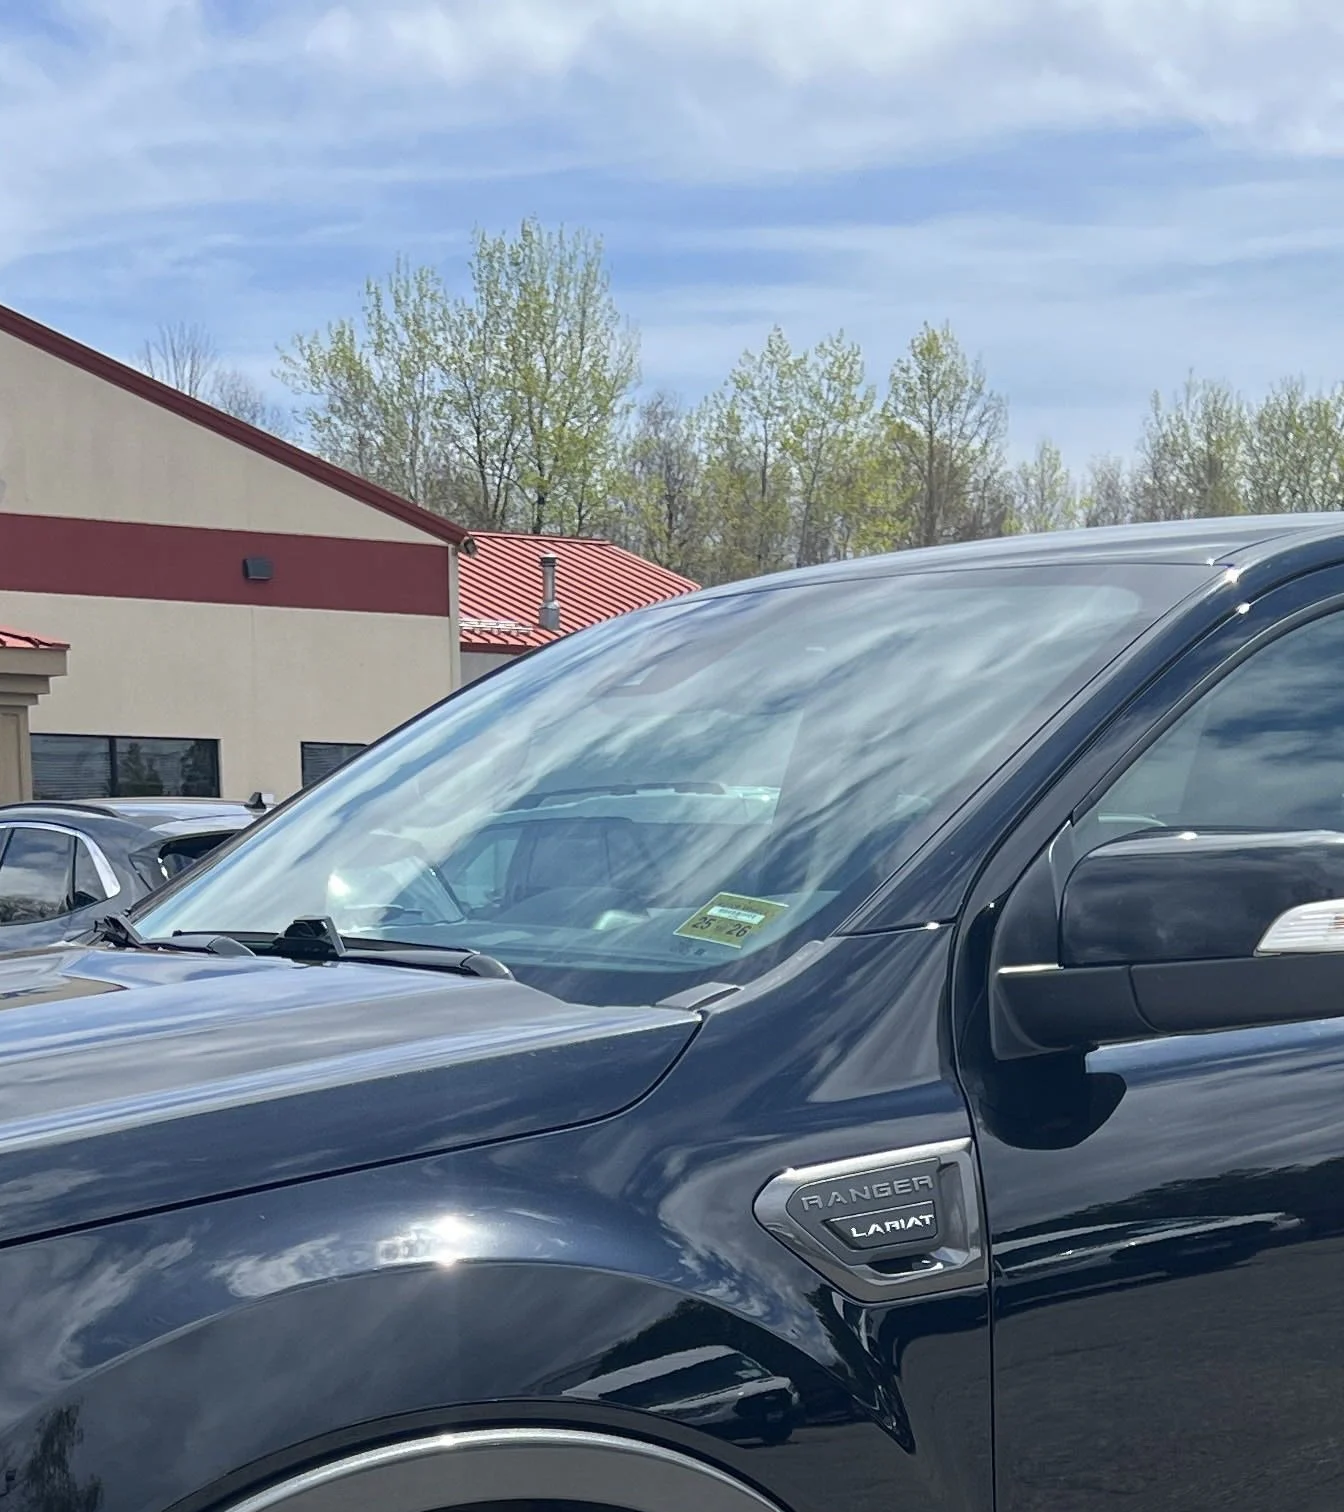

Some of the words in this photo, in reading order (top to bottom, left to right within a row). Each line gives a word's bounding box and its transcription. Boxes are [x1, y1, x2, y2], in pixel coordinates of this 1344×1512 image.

[692, 916, 718, 930] 25
[726, 923, 752, 937] 26
[801, 1175, 933, 1211] RANGER
[851, 1214, 934, 1238] LARIAT
